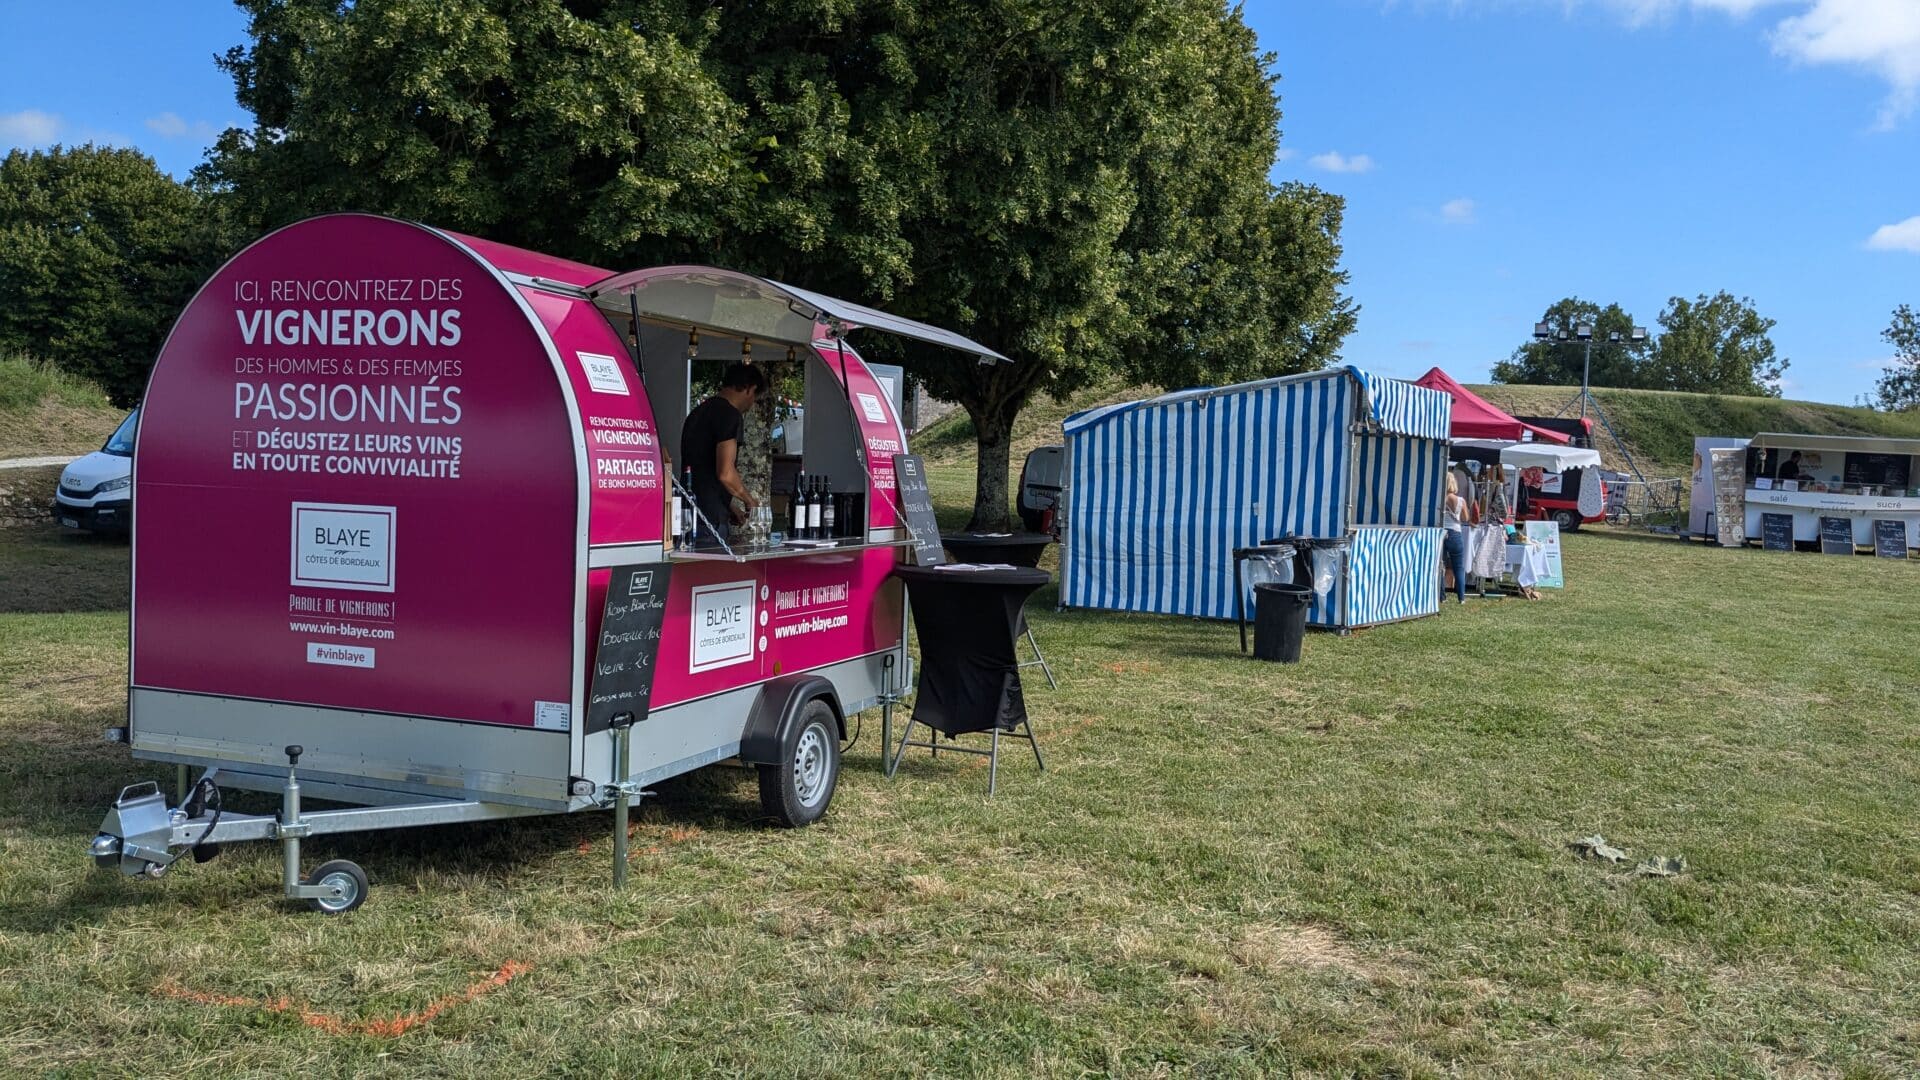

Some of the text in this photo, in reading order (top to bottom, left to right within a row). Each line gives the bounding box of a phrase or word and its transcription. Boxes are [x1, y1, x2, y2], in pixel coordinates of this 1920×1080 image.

[235, 279, 463, 304] ICI, RENCONTREZ DES
[236, 309, 461, 346] VIGNERONS
[235, 358, 462, 376] DES HOMMES & DES FEMMES
[235, 376, 461, 424] PASSIONNÉS
[589, 416, 649, 429] RENCONTRER NOS
[233, 427, 462, 455] ET DÉGUSTEZ LEURS VINS
[592, 429, 652, 446] VIGNERONS
[868, 436, 899, 451] DÉGUSTER
[233, 452, 460, 479] EN TOUTE CONVIVIALITÉ
[597, 458, 655, 476] PARTAGER
[599, 479, 656, 489] DE BONS MOMENTS
[1876, 501, 1902, 509] sucré
[315, 527, 371, 547] BLAYE
[305, 554, 380, 567] CÔTES DE BORDEAUX
[289, 594, 321, 612] PAROLE
[325, 599, 336, 612] DE
[775, 590, 800, 614] PAROLE
[802, 588, 810, 606] DE
[706, 605, 742, 627] BLAYE
[290, 621, 394, 640] www.vin-blaye.com
[775, 615, 848, 639] www.vin-blaye.com
[700, 632, 746, 647] CÔTES DE BORDEAUX
[316, 647, 365, 662] #vinblaye
[598, 662, 623, 675] Verre
